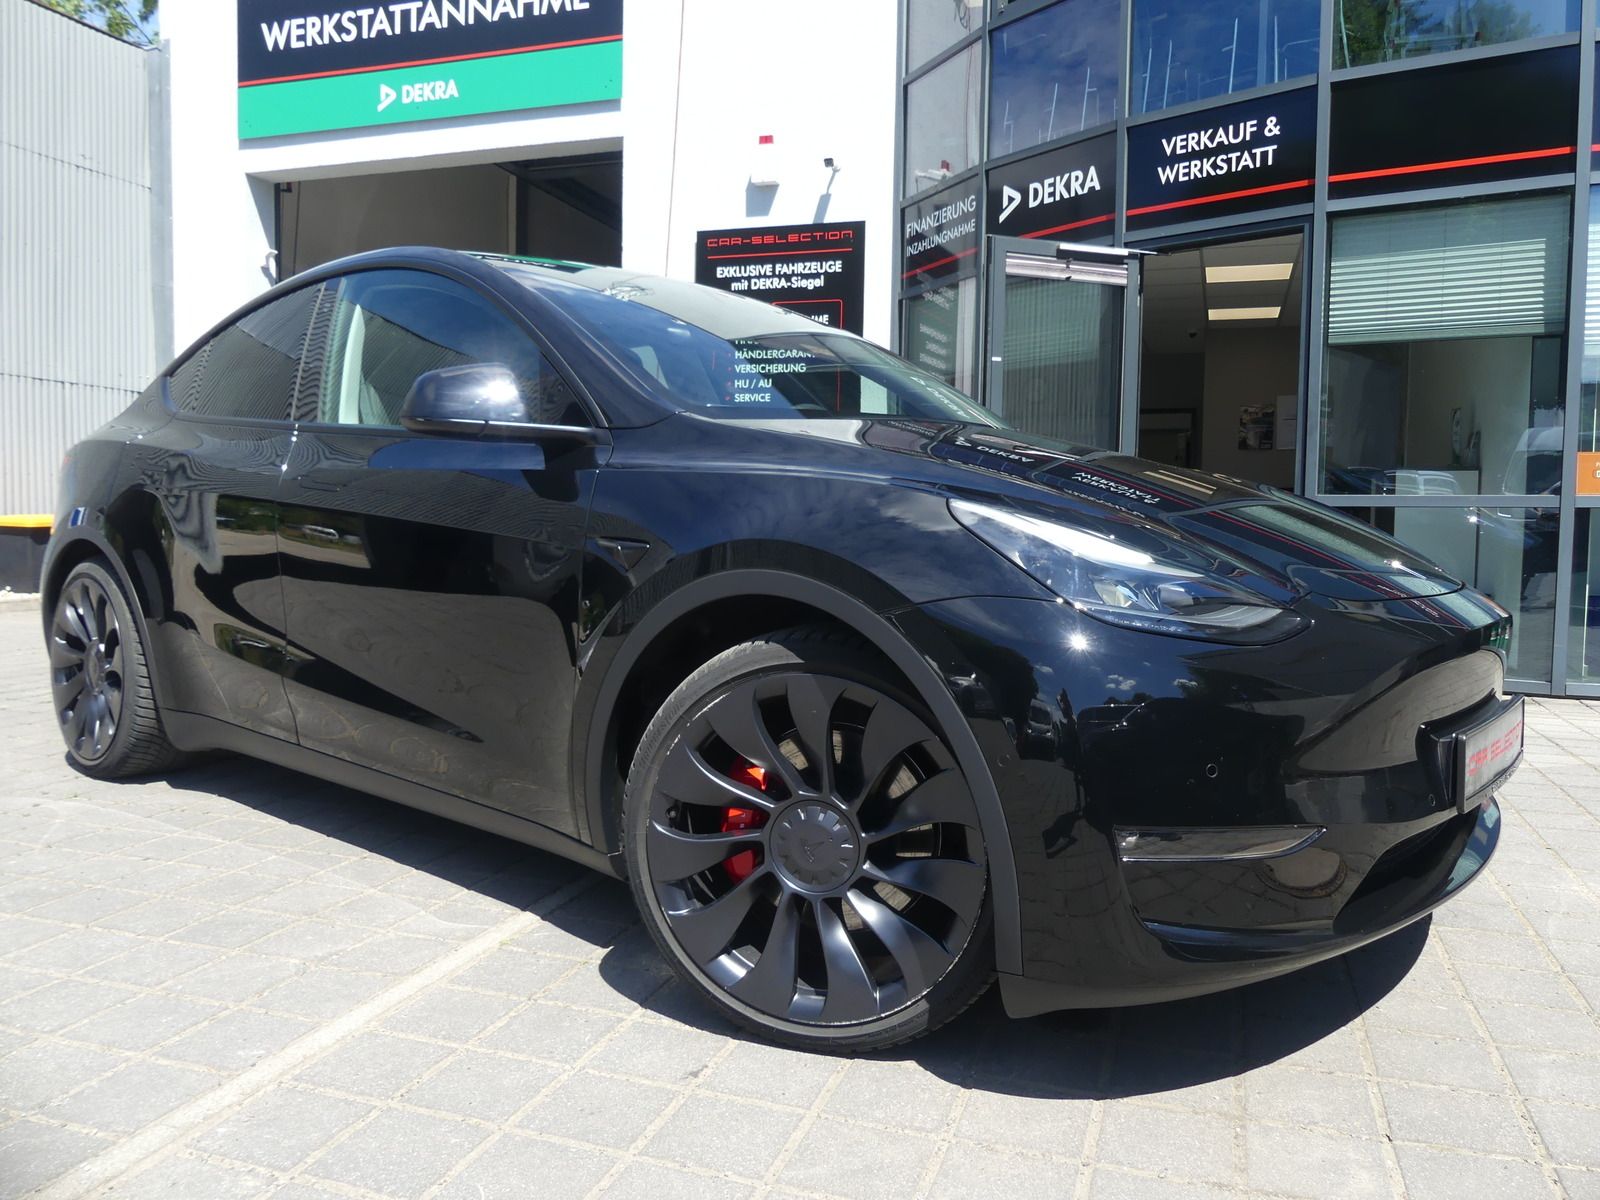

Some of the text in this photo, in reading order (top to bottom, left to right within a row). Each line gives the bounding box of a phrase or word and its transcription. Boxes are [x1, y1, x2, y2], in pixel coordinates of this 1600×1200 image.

[402, 79, 459, 105] DEKRA
[1161, 116, 1281, 157] VERKAUF &
[1158, 145, 1278, 185] WERKSTATT
[1028, 166, 1101, 209] DEKRA
[906, 195, 977, 239] FINANZIERUNG
[707, 230, 853, 248] CAR-SELECTION
[906, 219, 976, 257] INZAHLUNGNAHME
[716, 260, 843, 279] EXKLUSIVE FAHRZEUGE
[731, 275, 824, 291] mit DEKRA-Siegel
[735, 348, 816, 359] HÄNDLERGARAN
[734, 363, 807, 374] VERSICHERUNG
[735, 379, 749, 389] HU
[758, 378, 772, 388] AU
[734, 393, 771, 402] SERVICE
